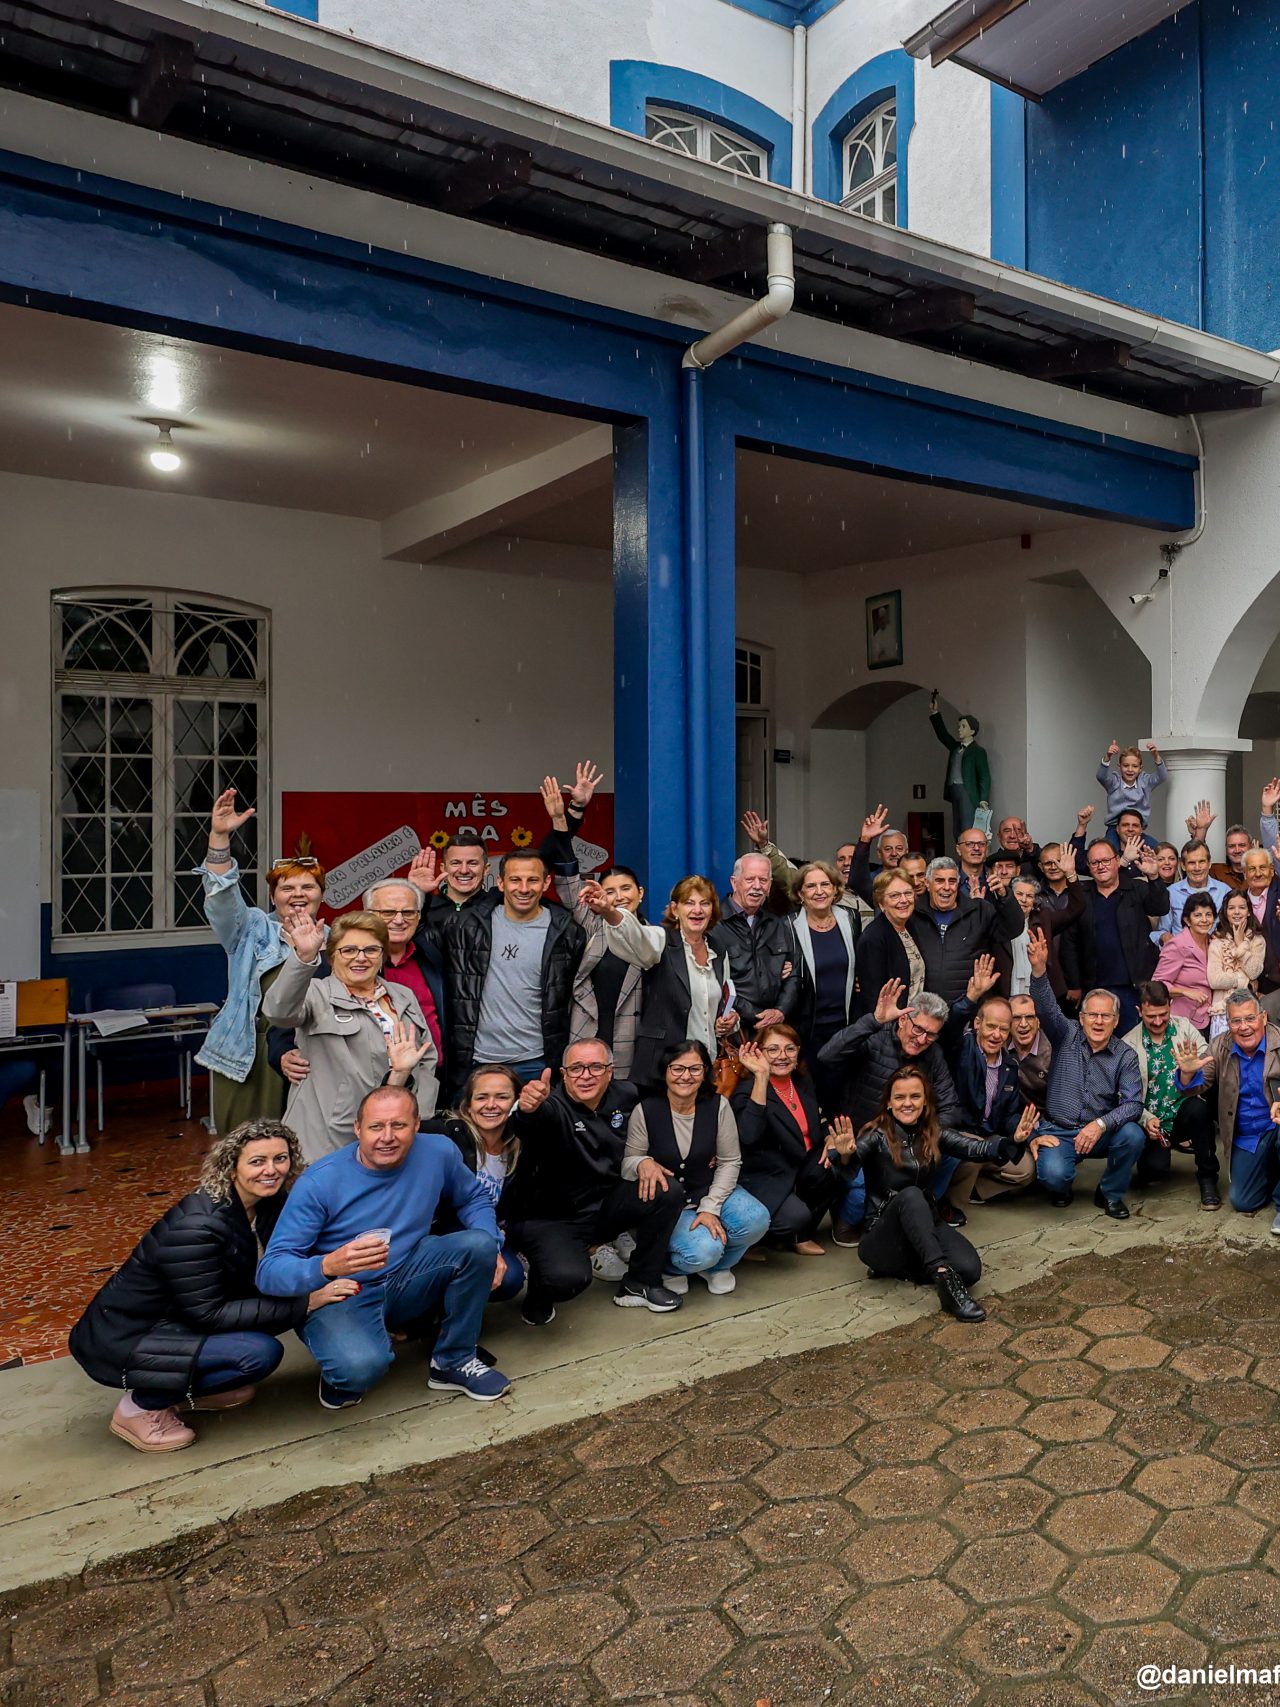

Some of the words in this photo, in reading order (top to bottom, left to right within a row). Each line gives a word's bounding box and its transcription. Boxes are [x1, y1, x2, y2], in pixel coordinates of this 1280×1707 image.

[445, 793, 508, 817] MÊS
[325, 870, 346, 889] UA
[349, 834, 402, 872] PALAVRA
[576, 843, 607, 861] MEUS
[326, 866, 384, 906] LÂMPADA
[387, 845, 419, 868] PARA
